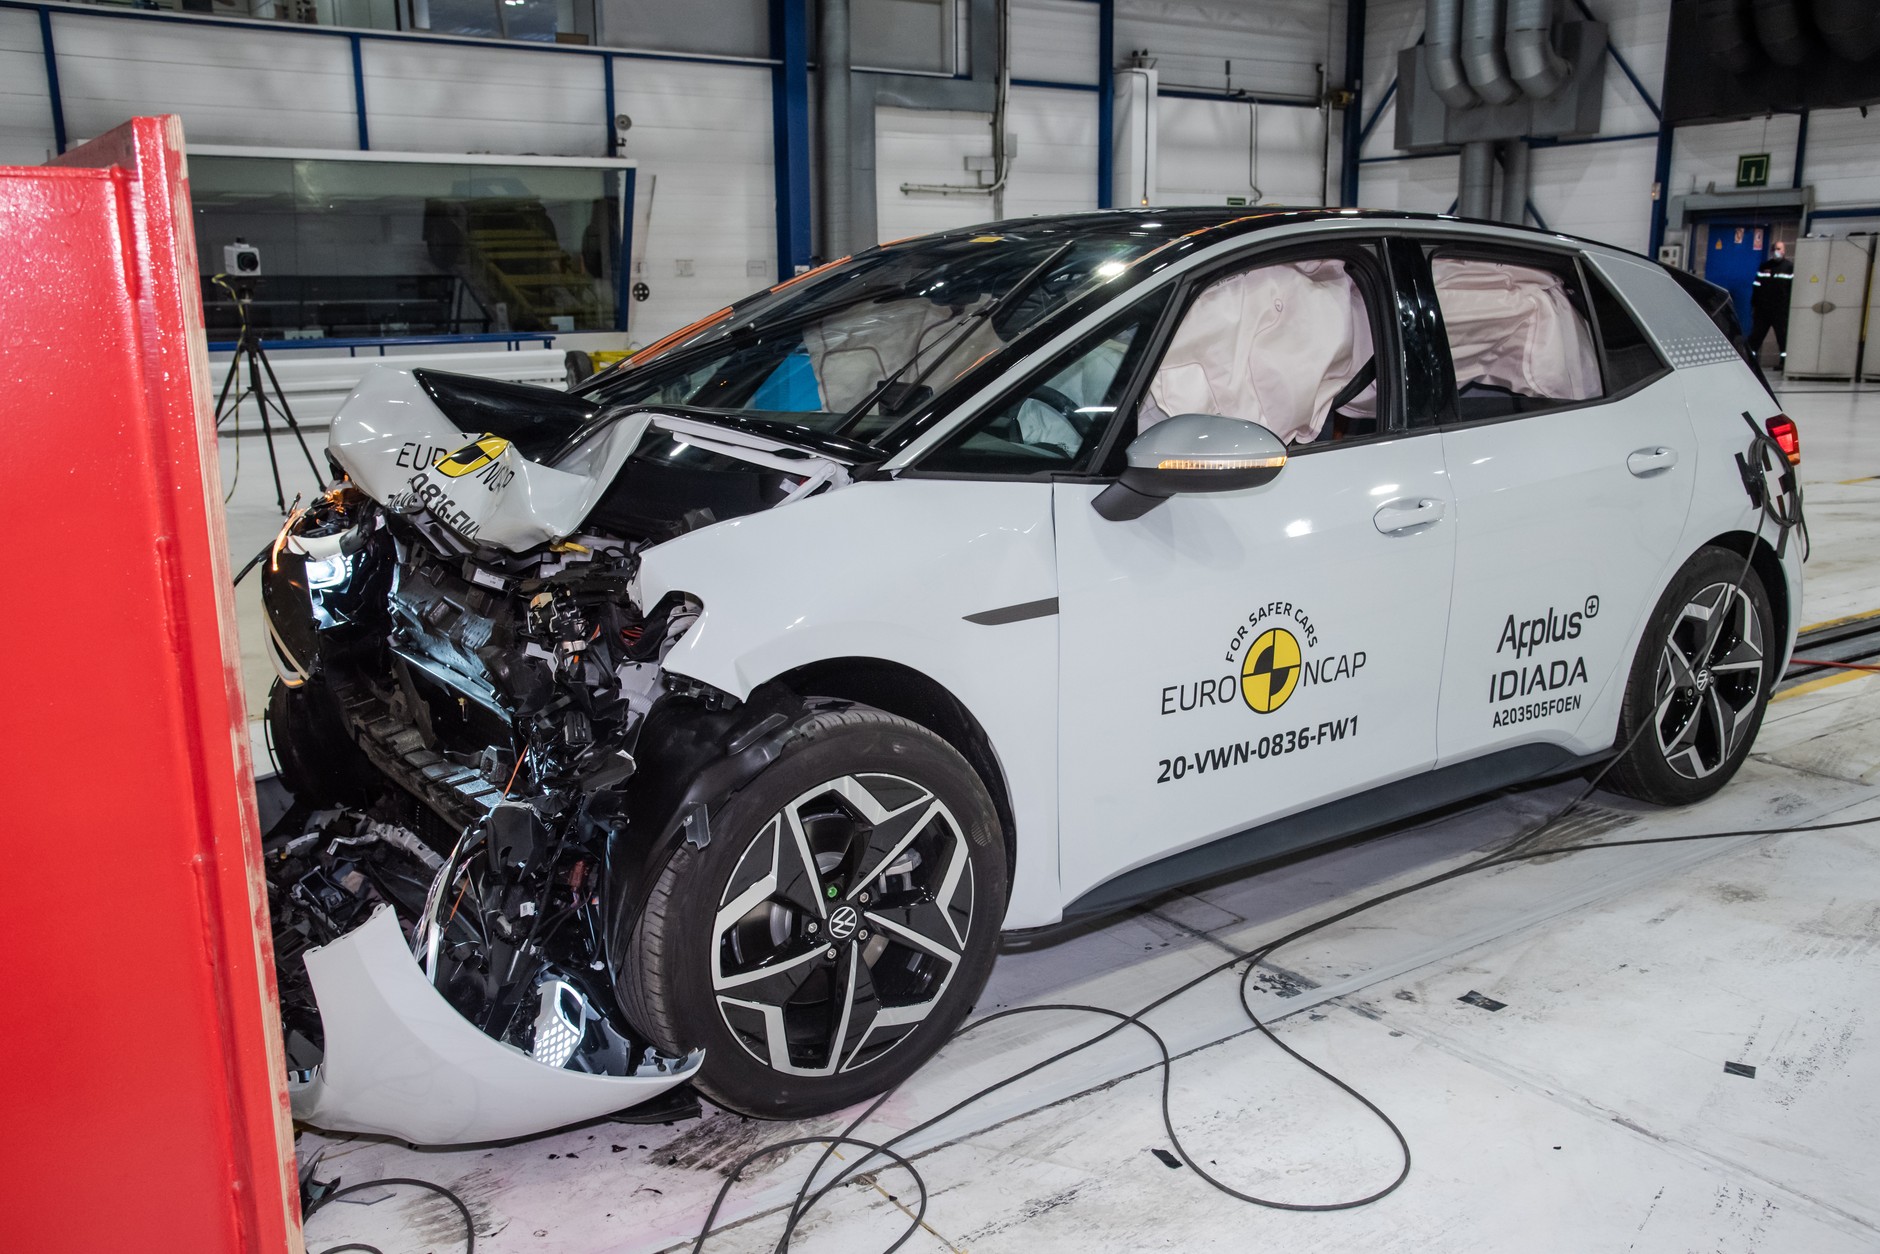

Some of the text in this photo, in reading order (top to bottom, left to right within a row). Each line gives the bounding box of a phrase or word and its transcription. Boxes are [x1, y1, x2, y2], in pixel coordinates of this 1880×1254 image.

[1225, 601, 1318, 663] FOR SAFER CARS
[1496, 607, 1583, 659] Applus
[1161, 651, 1367, 715] EURO NCAP
[1489, 656, 1588, 703] IDIADA
[1157, 715, 1359, 784] 20-VWN-0836-FW1
